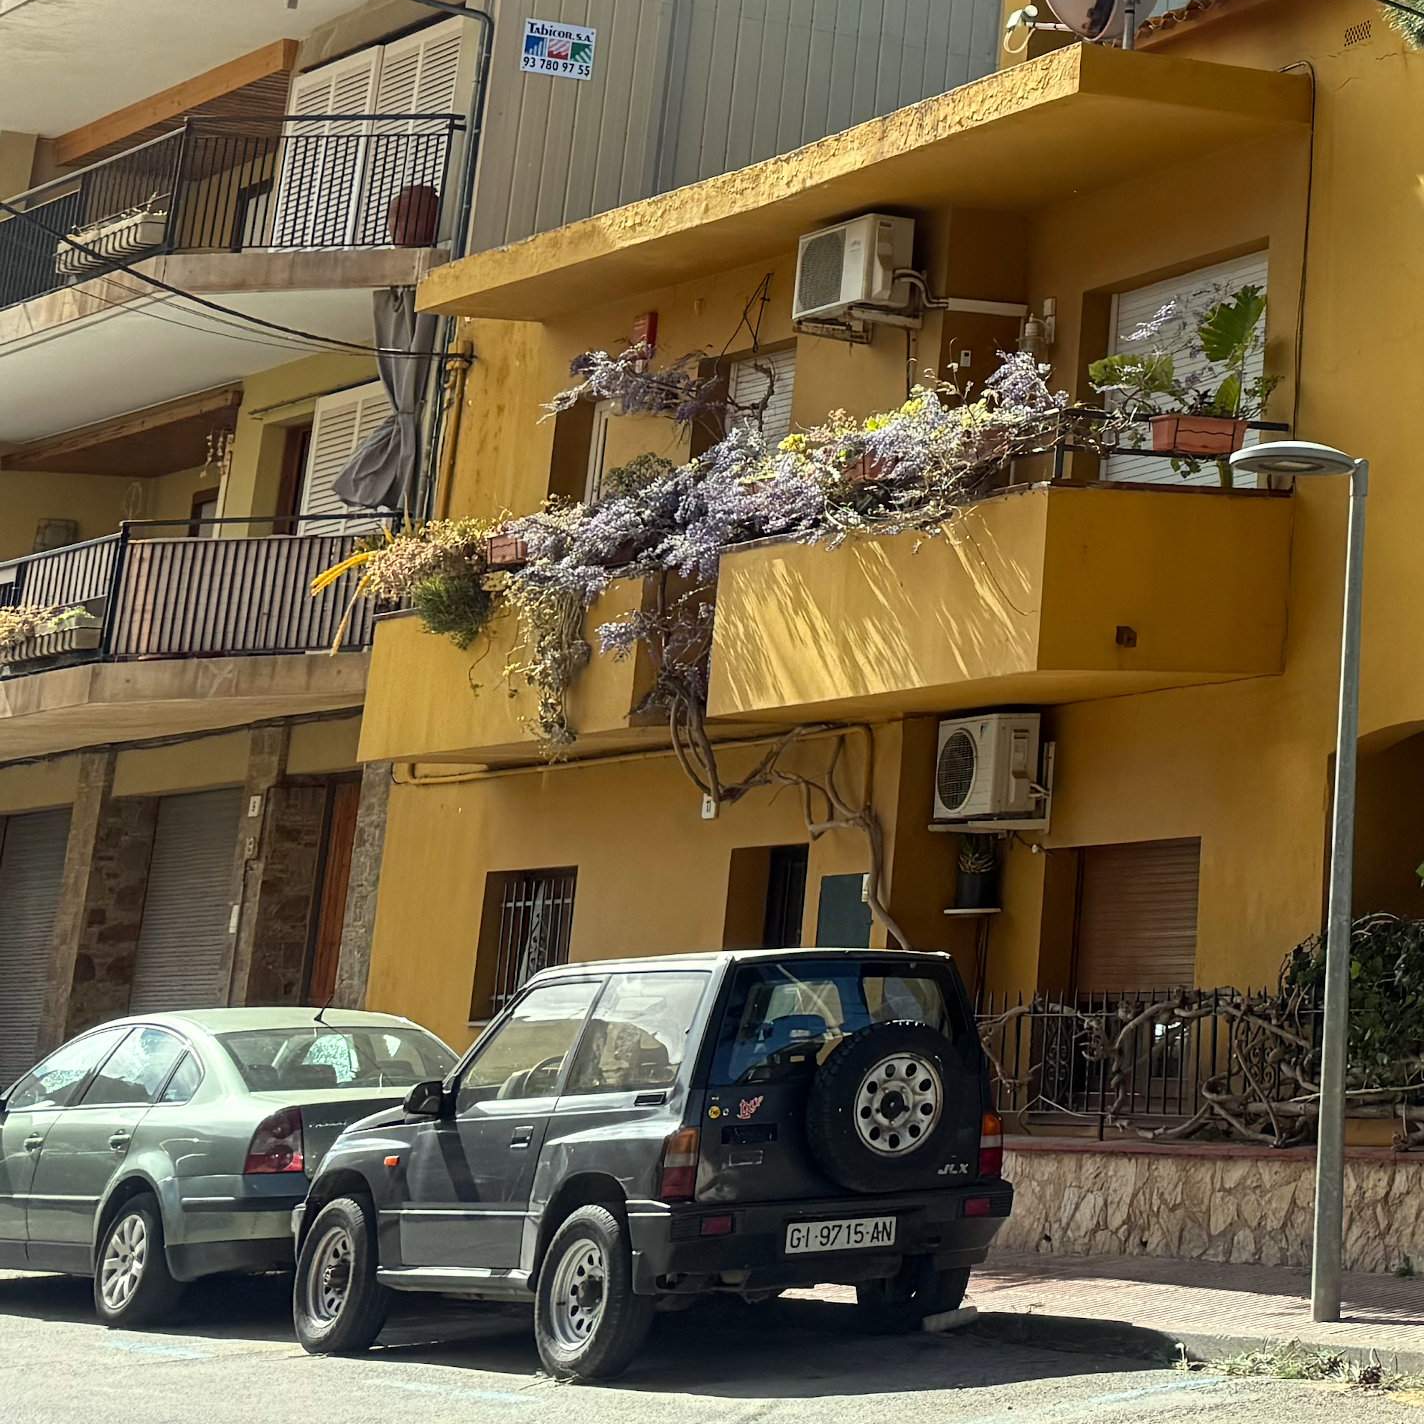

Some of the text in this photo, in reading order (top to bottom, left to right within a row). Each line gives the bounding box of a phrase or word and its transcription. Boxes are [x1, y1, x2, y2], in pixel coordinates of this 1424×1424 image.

[523, 57, 590, 77] 93 780 97 55
